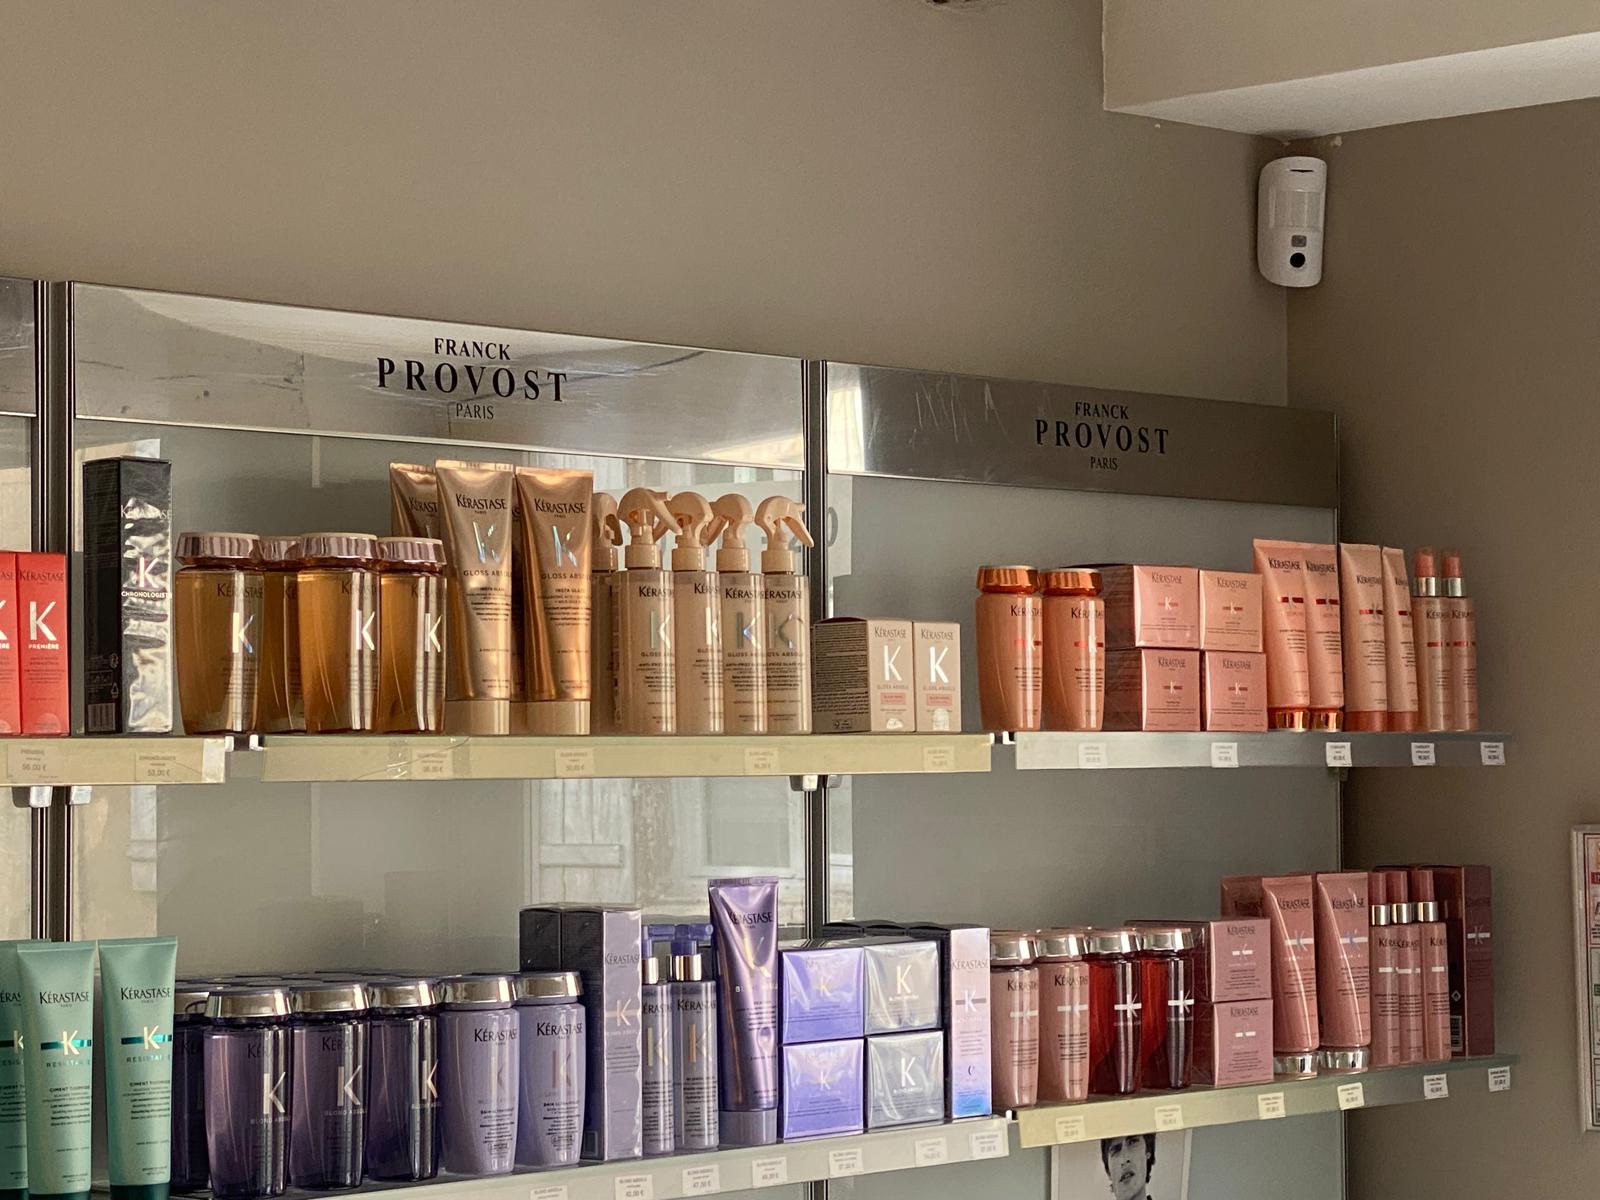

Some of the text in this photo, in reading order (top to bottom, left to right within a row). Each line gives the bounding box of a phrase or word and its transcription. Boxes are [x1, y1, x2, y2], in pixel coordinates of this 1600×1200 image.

[434, 337, 511, 361] FRANCK
[376, 357, 568, 403] PROVOST
[455, 402, 494, 420] PARIS
[1074, 401, 1129, 420] FRANCK
[1034, 419, 1169, 455] PROVOST
[1089, 456, 1118, 471] PARIS
[456, 493, 507, 511] KÉRASTASE
[534, 498, 586, 514] KÉRASTASE
[139, 557, 159, 587] K
[29, 601, 57, 641] K
[232, 614, 254, 654] K
[355, 610, 376, 651] K
[424, 613, 442, 653] K
[874, 626, 907, 639] KÉRASTASE
[921, 629, 954, 641] KÉRASTASE
[884, 645, 902, 681] K
[929, 646, 949, 683] K
[896, 964, 912, 995] K
[39, 990, 90, 1005] KÉRASTASE
[121, 987, 171, 1002] KÉRASTASE
[964, 989, 977, 1013] K
[616, 998, 631, 1027] K
[63, 1030, 80, 1056] K
[143, 1025, 160, 1051] K
[536, 1022, 583, 1037] KÉRASTASE
[337, 1065, 362, 1107] K
[422, 1059, 439, 1100] K
[901, 1057, 916, 1087] K
[263, 1071, 286, 1115] K
